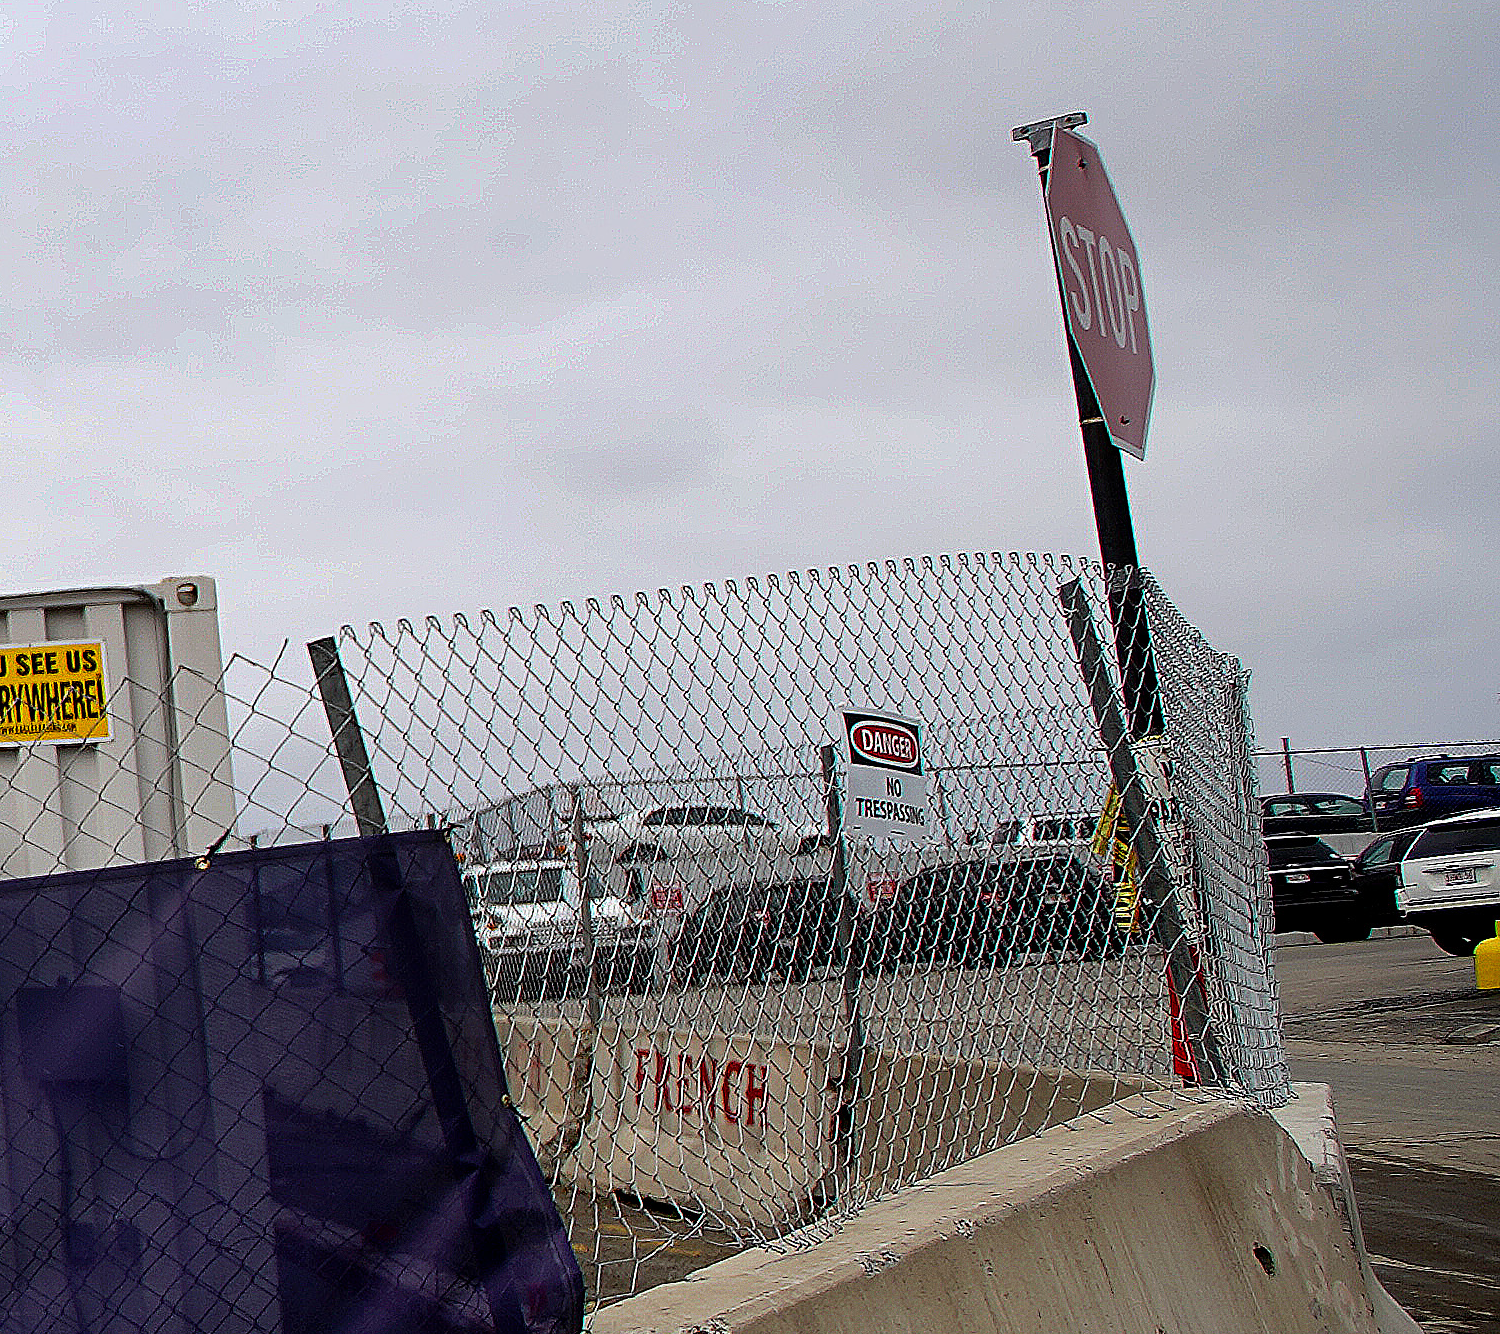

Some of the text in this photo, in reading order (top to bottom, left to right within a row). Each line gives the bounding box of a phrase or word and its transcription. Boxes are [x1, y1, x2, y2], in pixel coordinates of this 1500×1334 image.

[1060, 215, 1140, 355] STOP
[15, 652, 59, 676] SEE
[66, 650, 97, 673] US
[862, 729, 913, 759] DANGER
[886, 777, 902, 797] NO
[855, 798, 925, 826] TRESPASSING
